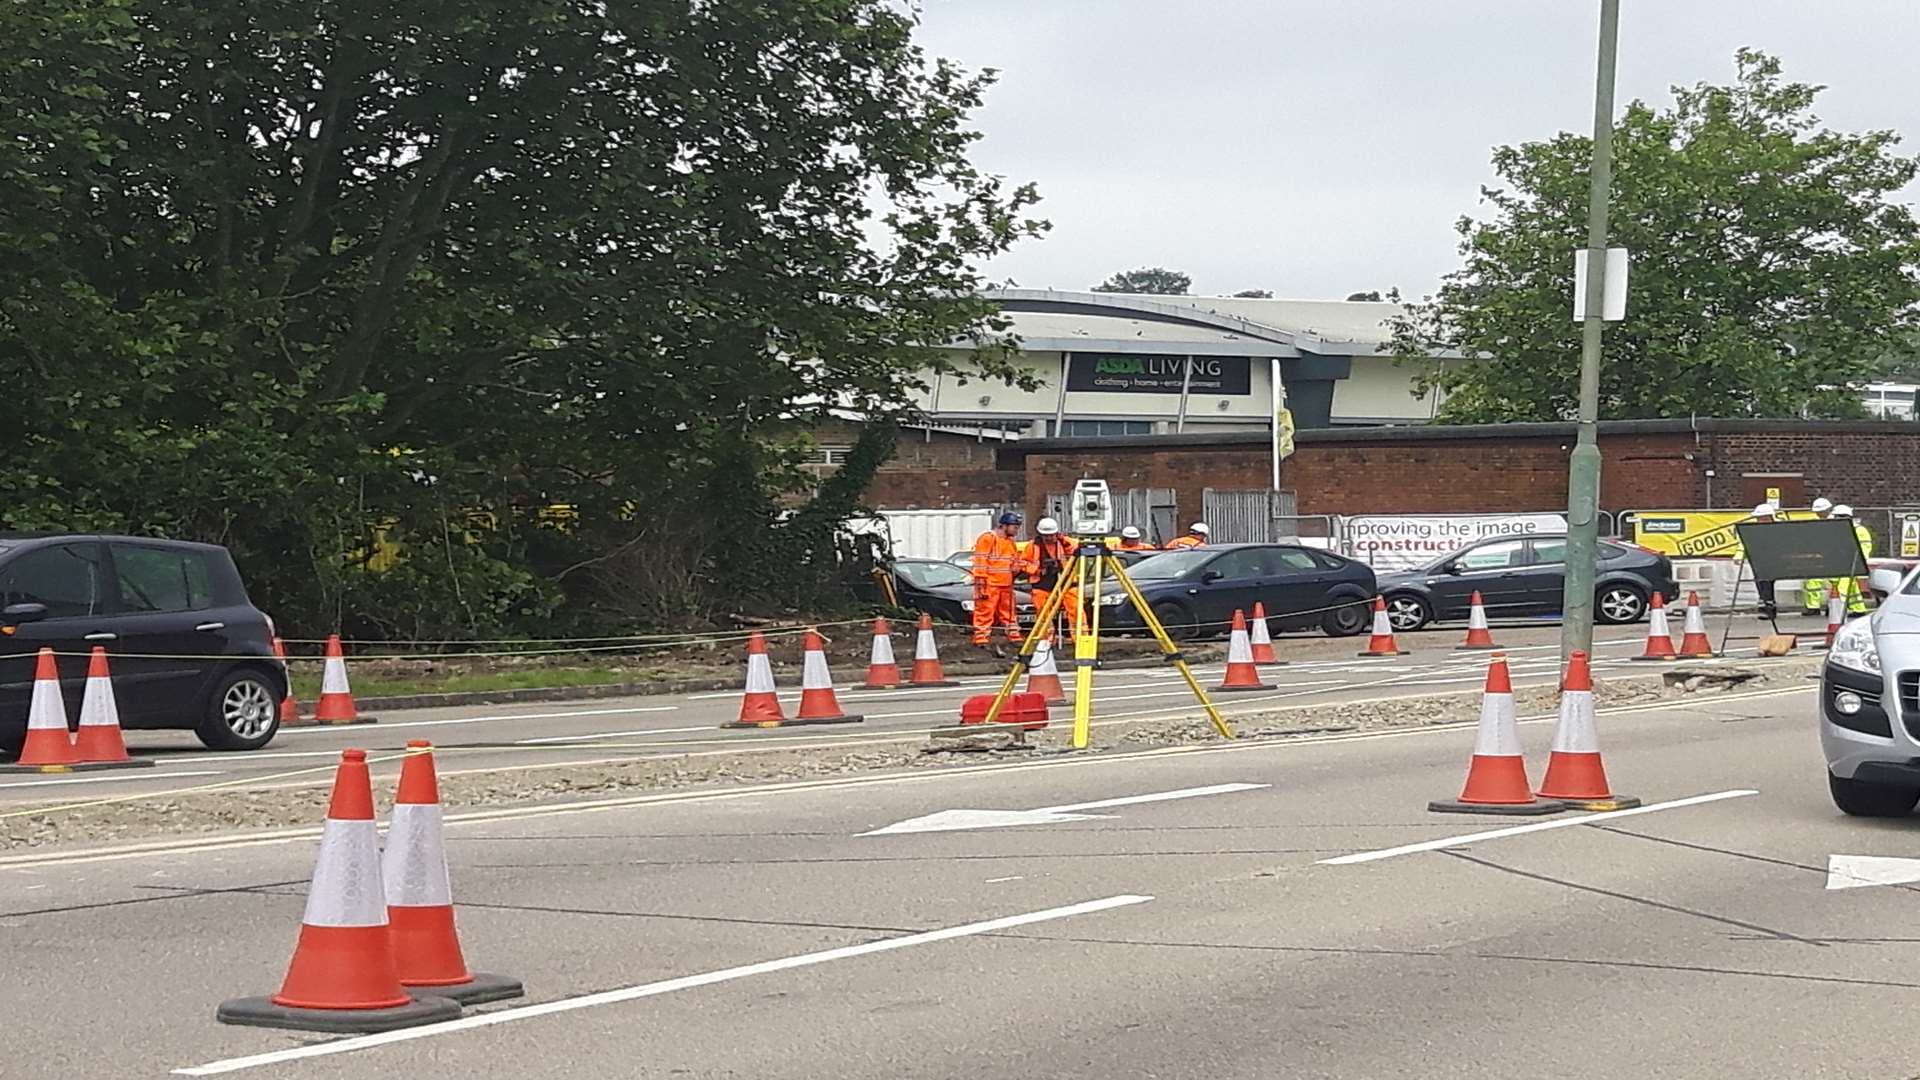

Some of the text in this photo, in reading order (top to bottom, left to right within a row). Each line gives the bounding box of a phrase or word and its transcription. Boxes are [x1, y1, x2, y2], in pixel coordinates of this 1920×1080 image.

[1095, 358, 1221, 375] ASDA LIVING
[1134, 377, 1158, 386] home
[1439, 521, 1470, 535] the
[1477, 522, 1536, 535] image
[1357, 538, 1473, 551] constructi
[1682, 531, 1726, 555] GOOD
